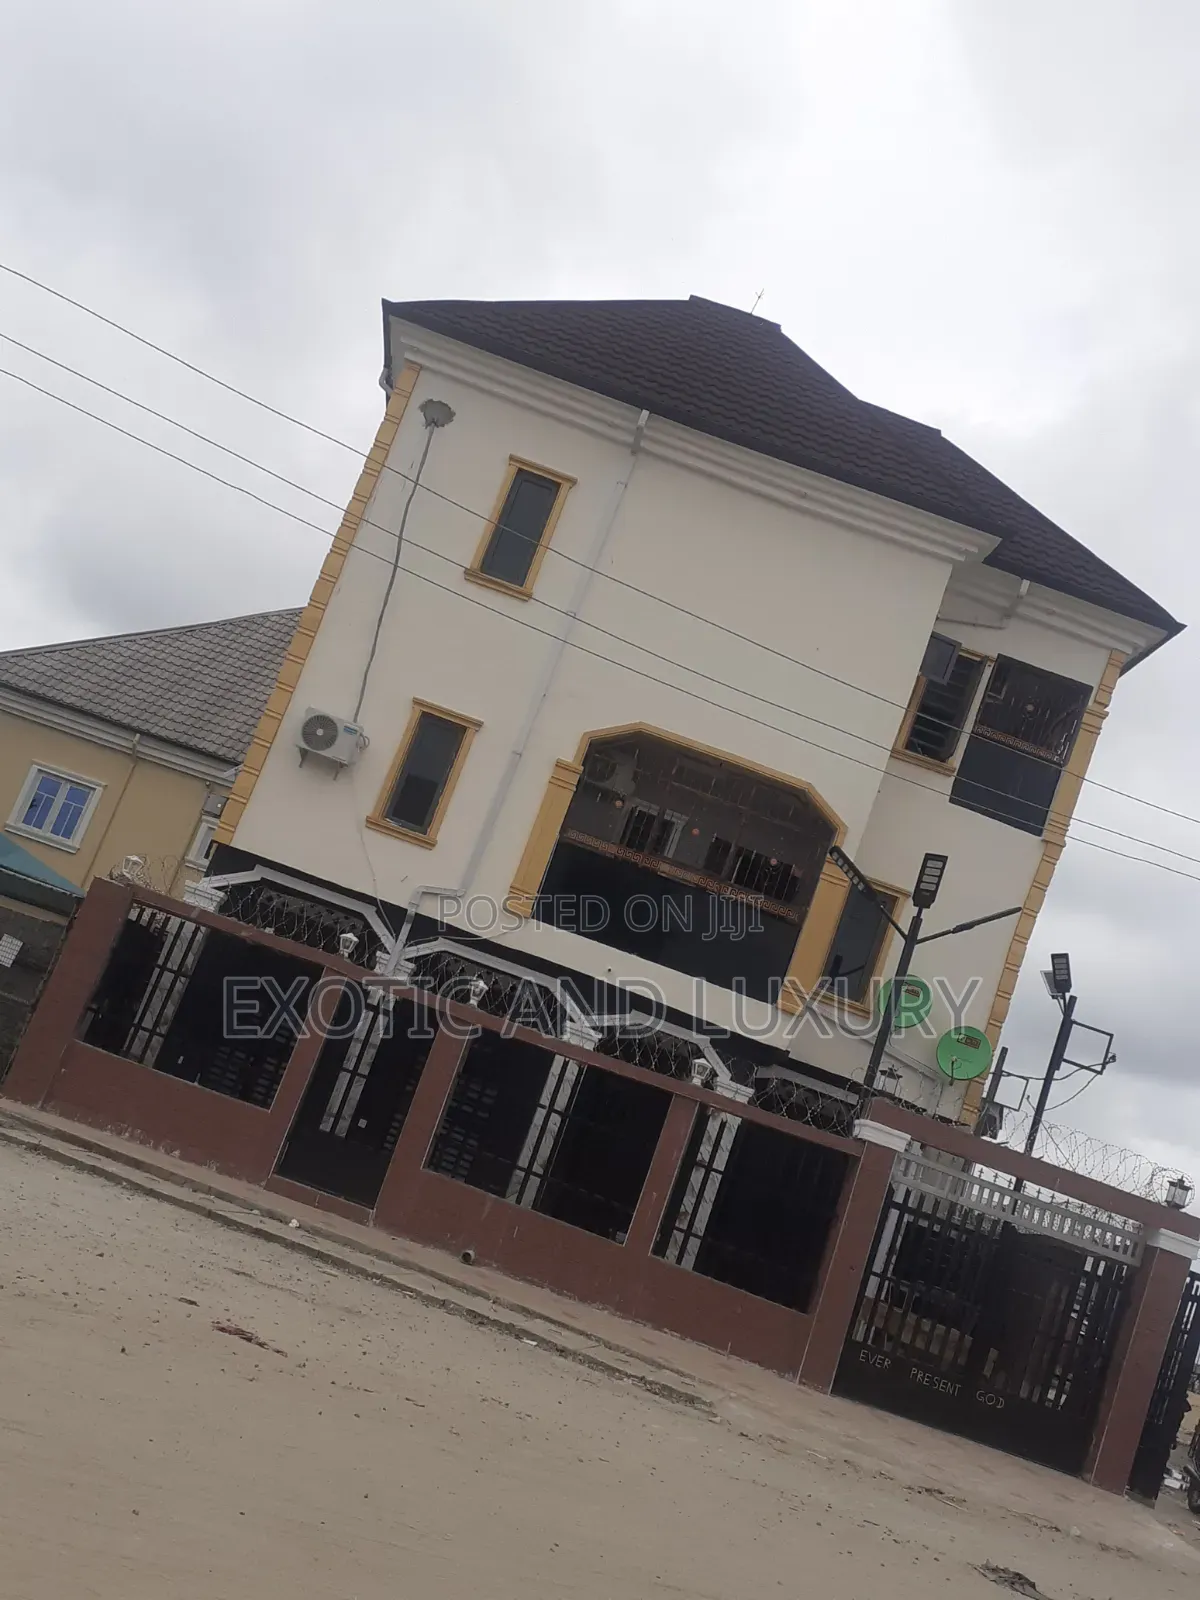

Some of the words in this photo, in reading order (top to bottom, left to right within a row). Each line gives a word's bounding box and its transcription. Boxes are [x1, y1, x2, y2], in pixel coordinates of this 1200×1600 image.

[859, 1349, 891, 1370] EVER
[909, 1367, 961, 1397] PRESENT
[975, 1389, 1005, 1409] GOD
